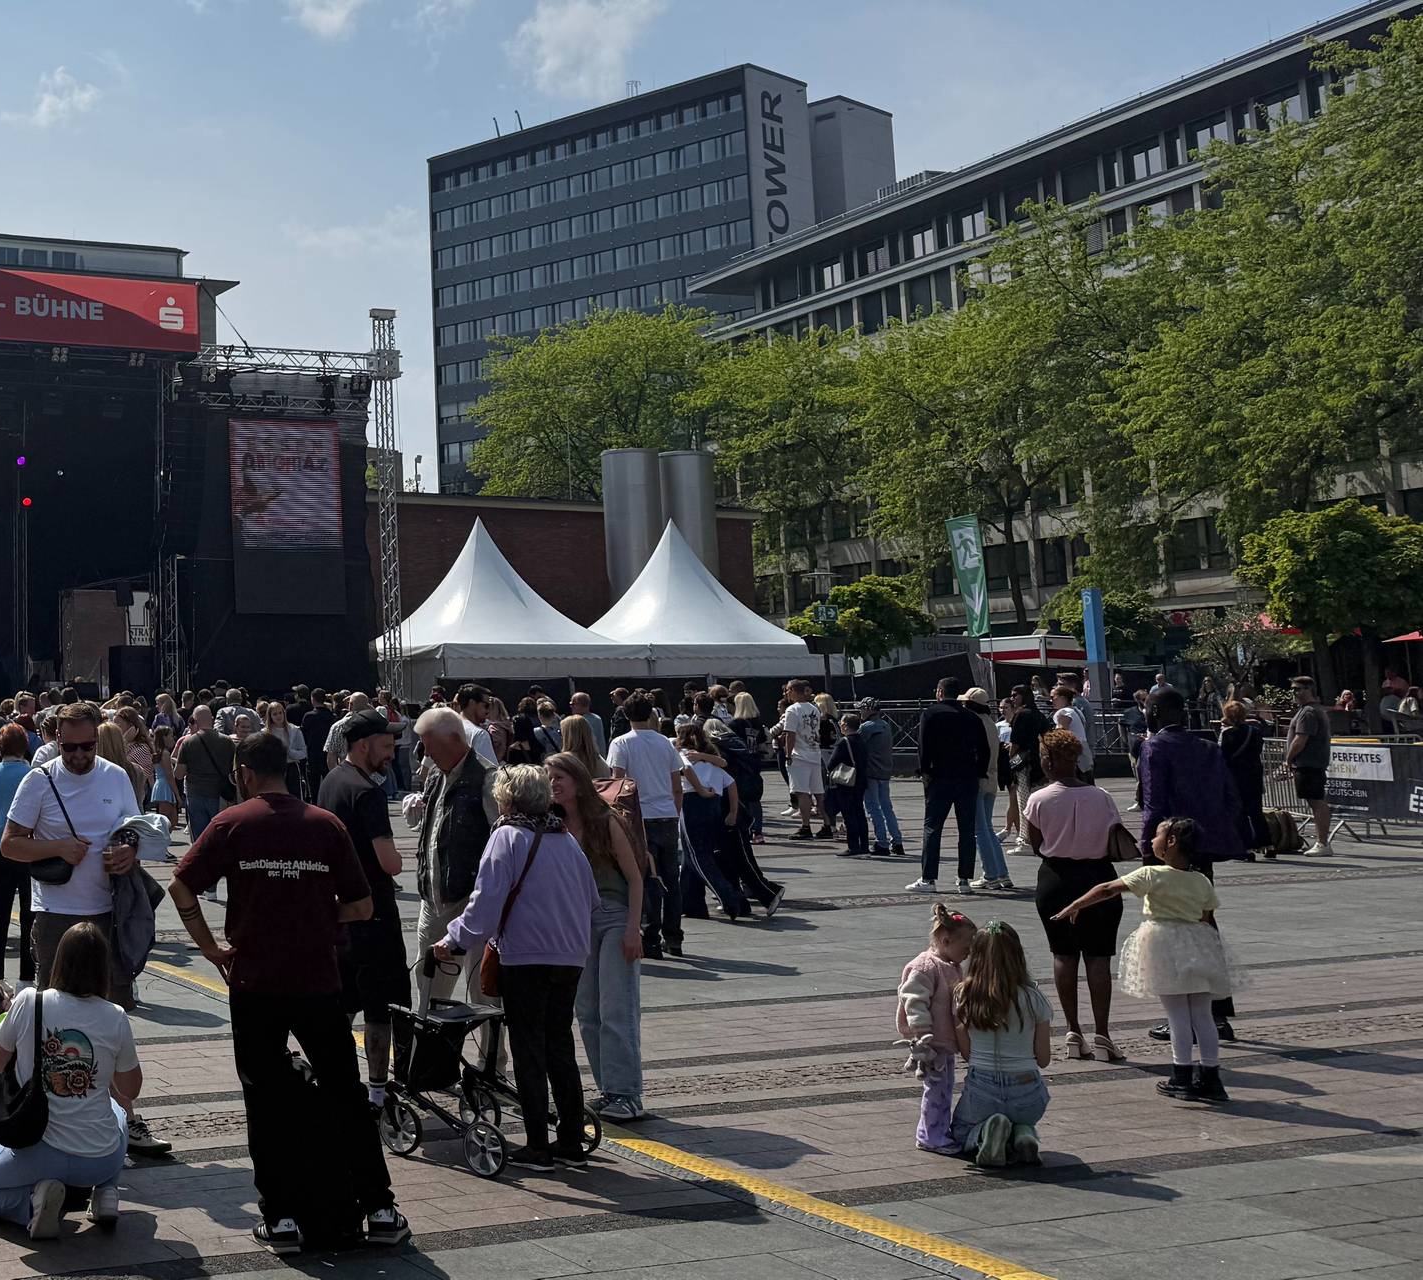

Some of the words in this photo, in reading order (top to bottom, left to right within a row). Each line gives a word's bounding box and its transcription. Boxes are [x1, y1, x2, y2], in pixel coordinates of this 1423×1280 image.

[15, 293, 104, 321] BÜHNE
[1332, 752, 1382, 763] PERFEKTES
[293, 859, 330, 873] Athletics
